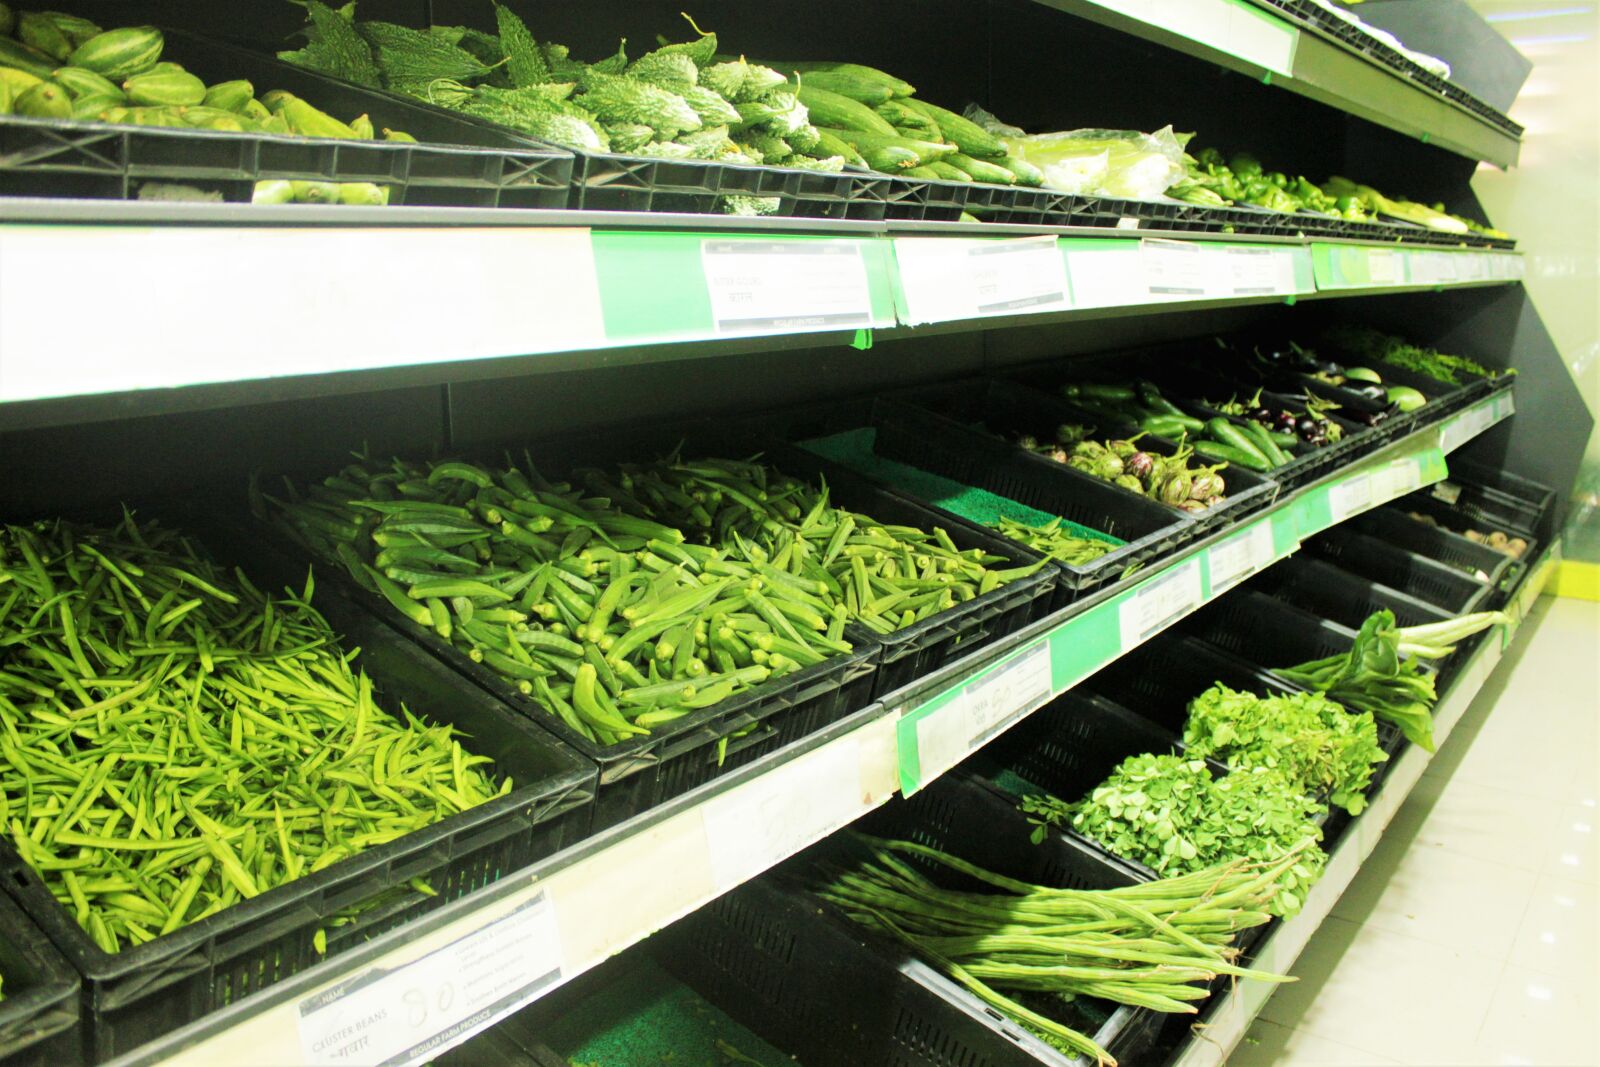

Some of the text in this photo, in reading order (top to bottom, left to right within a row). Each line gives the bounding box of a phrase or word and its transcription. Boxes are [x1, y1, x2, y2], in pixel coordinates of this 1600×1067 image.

[322, 987, 346, 1004] NAME
[312, 1009, 388, 1053] CLUSTER BEANS
[409, 1009, 492, 1058] REGULAR FARM PRODUCE
